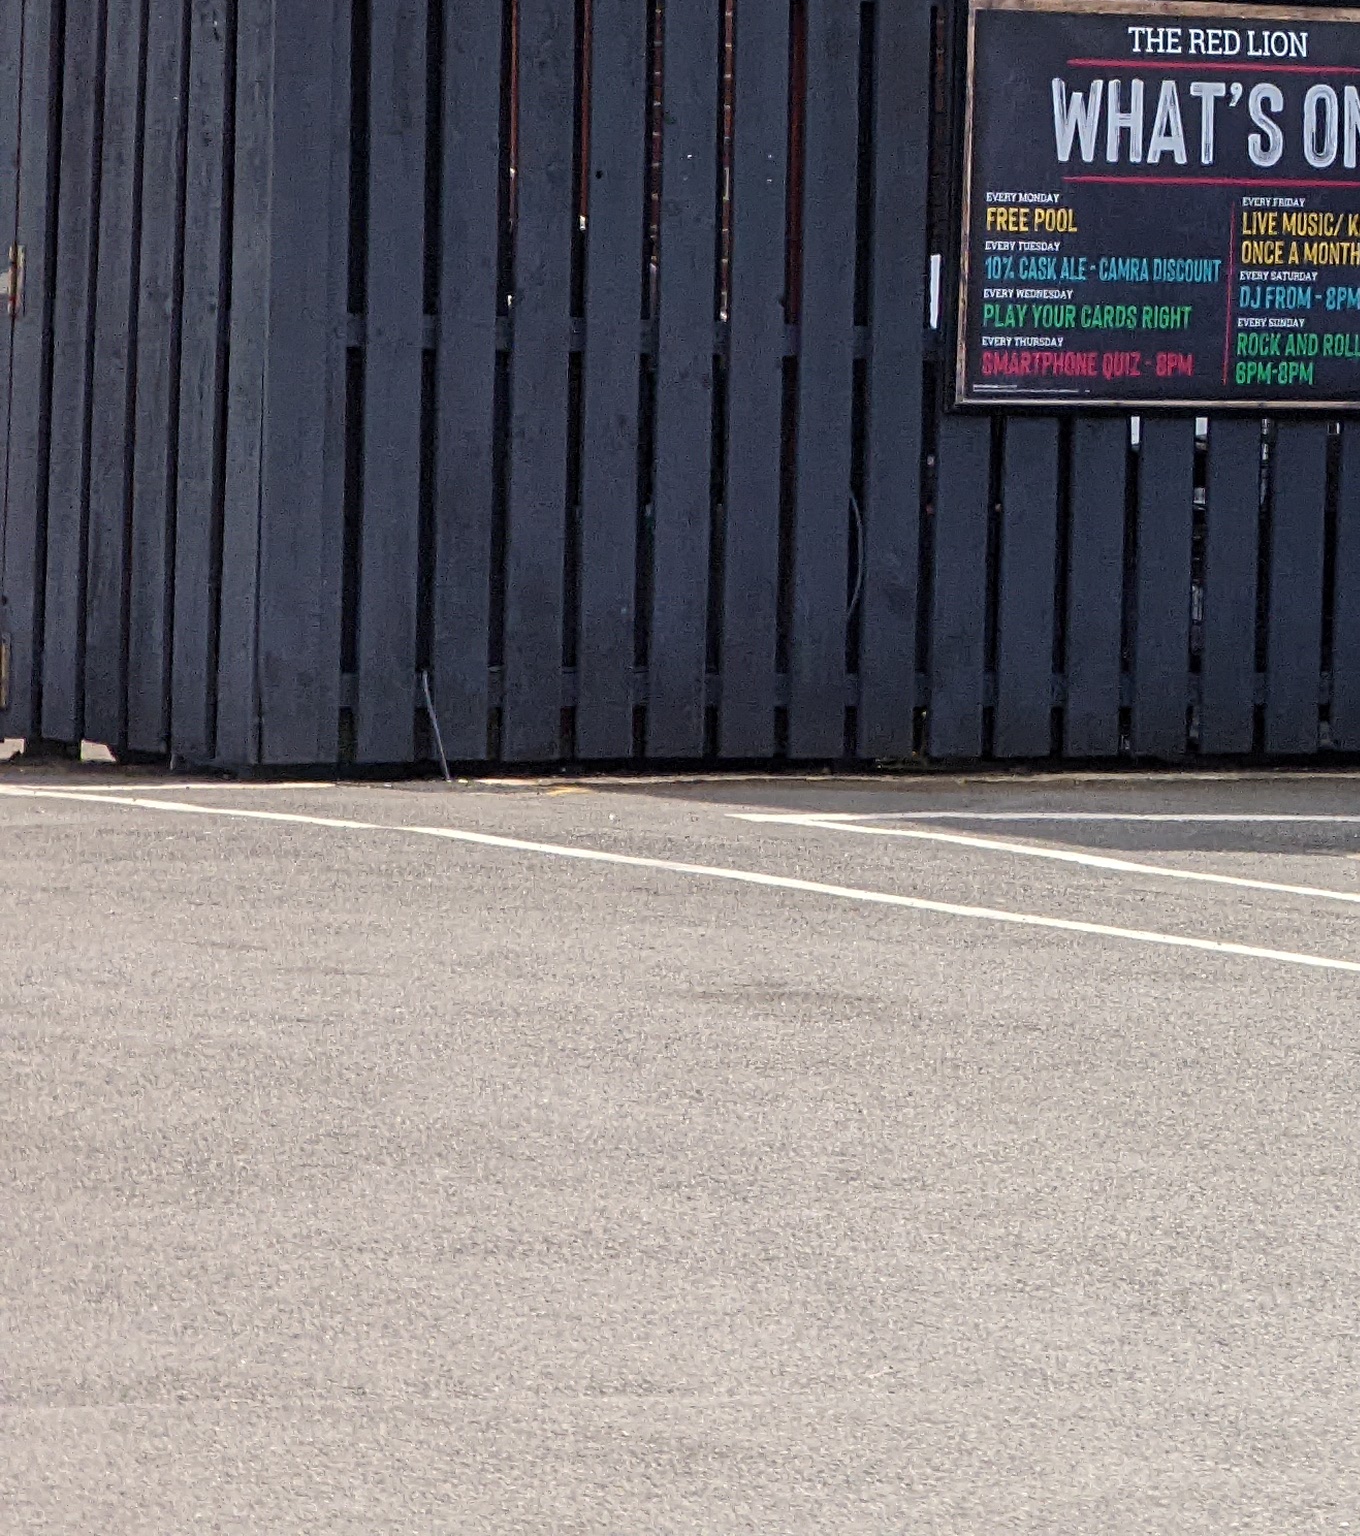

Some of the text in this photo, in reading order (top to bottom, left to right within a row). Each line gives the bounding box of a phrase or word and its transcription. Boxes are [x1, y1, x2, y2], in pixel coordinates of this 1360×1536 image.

[1128, 26, 1309, 58] THE RED LION
[1051, 77, 1285, 168] WHAT'S
[986, 192, 1060, 203] EVERY MONDAY
[1242, 197, 1306, 207] EVERY FRIDAY
[986, 207, 1077, 233] FREE POOL
[1242, 212, 1277, 236] LIVE
[985, 241, 1060, 252] EVERY TUESDAY
[1241, 241, 1285, 265] ONCE
[1288, 242, 1300, 265] A
[1304, 242, 1360, 267] MONTH
[985, 256, 1014, 280] 10%
[1019, 256, 1057, 281] CASK
[1060, 257, 1087, 281] ALE
[1099, 257, 1150, 282] CAMRA
[1152, 258, 1222, 283] DISCOUNT
[1239, 271, 1319, 282] EVERY SATURDAY
[983, 289, 1074, 300] EVERY WEDNESDAY
[1239, 285, 1261, 309] DJ
[1265, 286, 1311, 310] FROM
[982, 304, 1193, 331] PLAY YOUR CARDS RIGHT
[1237, 318, 1306, 328] EVERY SUNDAY
[982, 337, 1064, 348] EVERY THURSDAY
[1237, 332, 1282, 357] ROCK
[1285, 333, 1318, 357] AND
[981, 351, 1098, 377] SMARTPHONE
[1102, 351, 1141, 380] QUIZ
